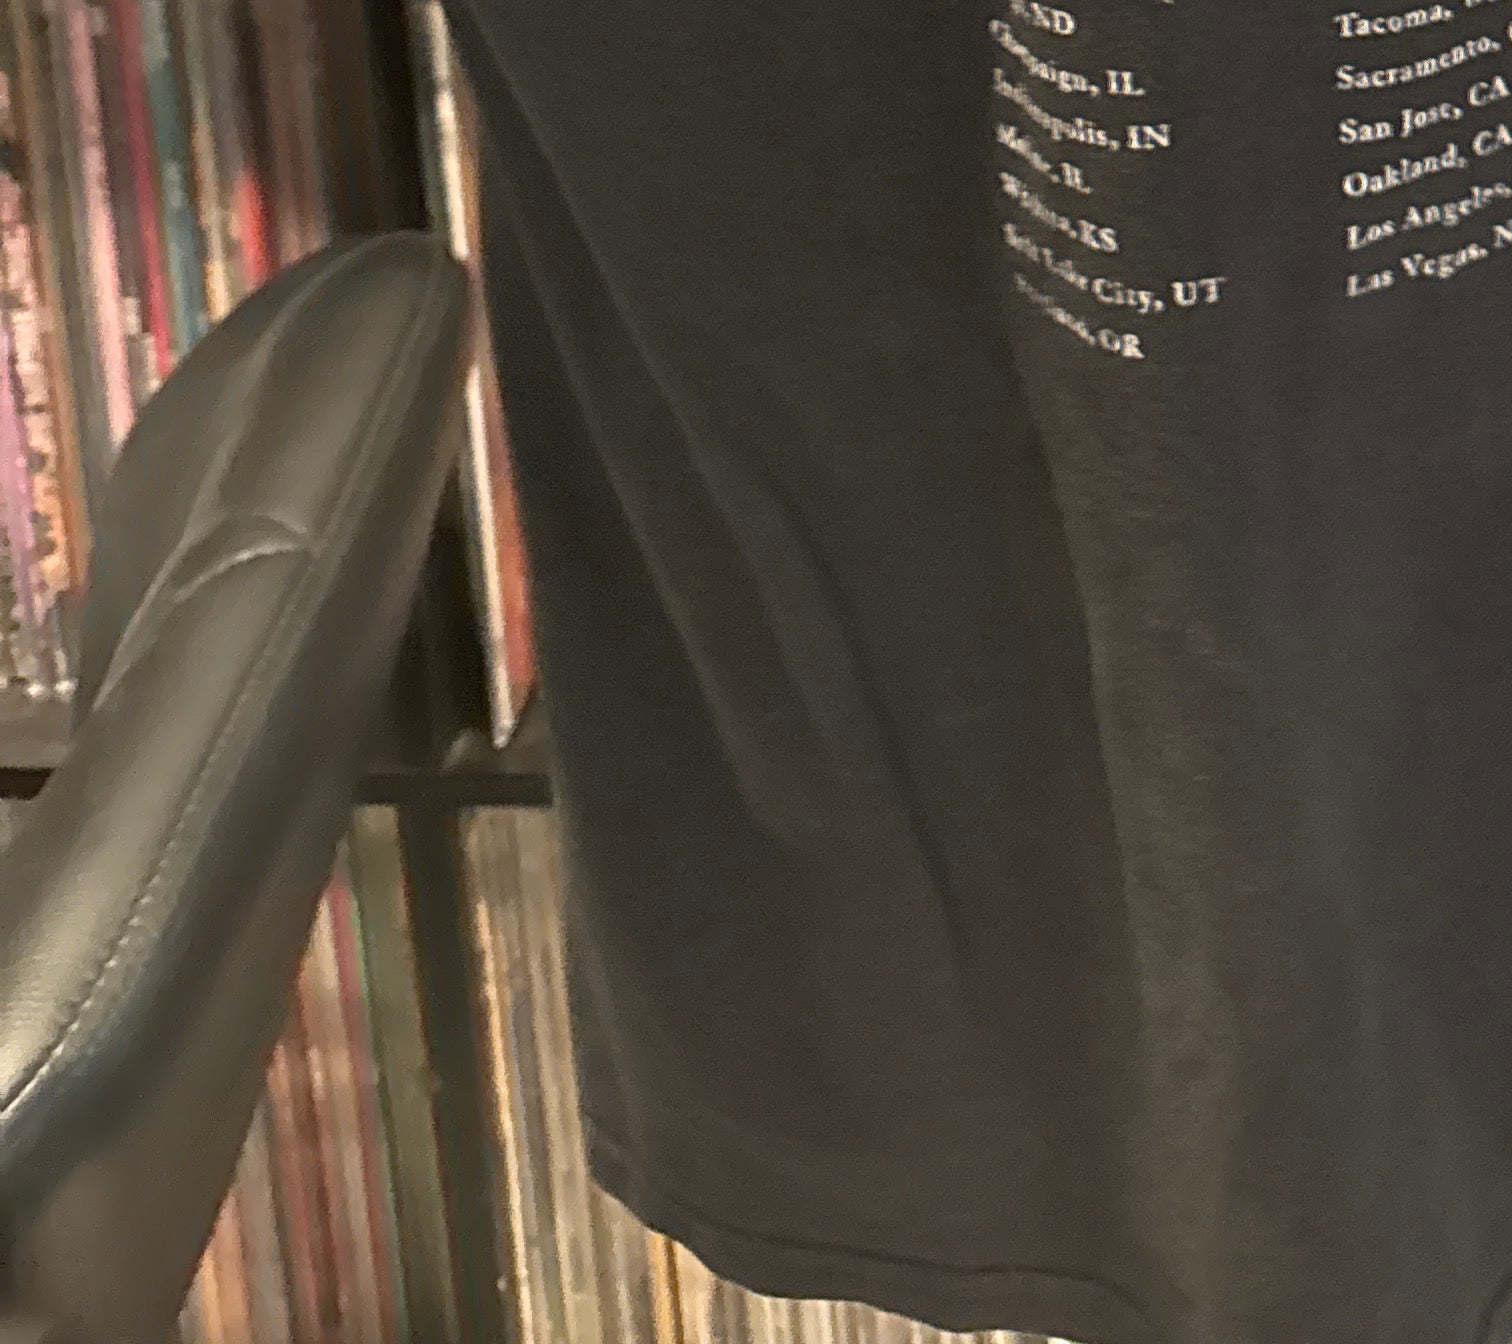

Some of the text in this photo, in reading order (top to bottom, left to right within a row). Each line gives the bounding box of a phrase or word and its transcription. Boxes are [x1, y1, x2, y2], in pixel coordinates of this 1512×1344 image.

[1333, 3, 1455, 39] Tacoma,
[1334, 35, 1502, 91] Sacramento,
[1105, 69, 1147, 96] IL
[1338, 117, 1395, 146] San
[1467, 75, 1512, 108] CA
[1126, 123, 1172, 150] IN
[1341, 142, 1468, 198] Oakland,
[1076, 219, 1120, 253] KS
[1345, 219, 1397, 251] Los
[1345, 269, 1396, 298] Las
[1400, 242, 1490, 280] Vegas,
[1170, 276, 1229, 307] UT
[1097, 327, 1146, 360] OR
